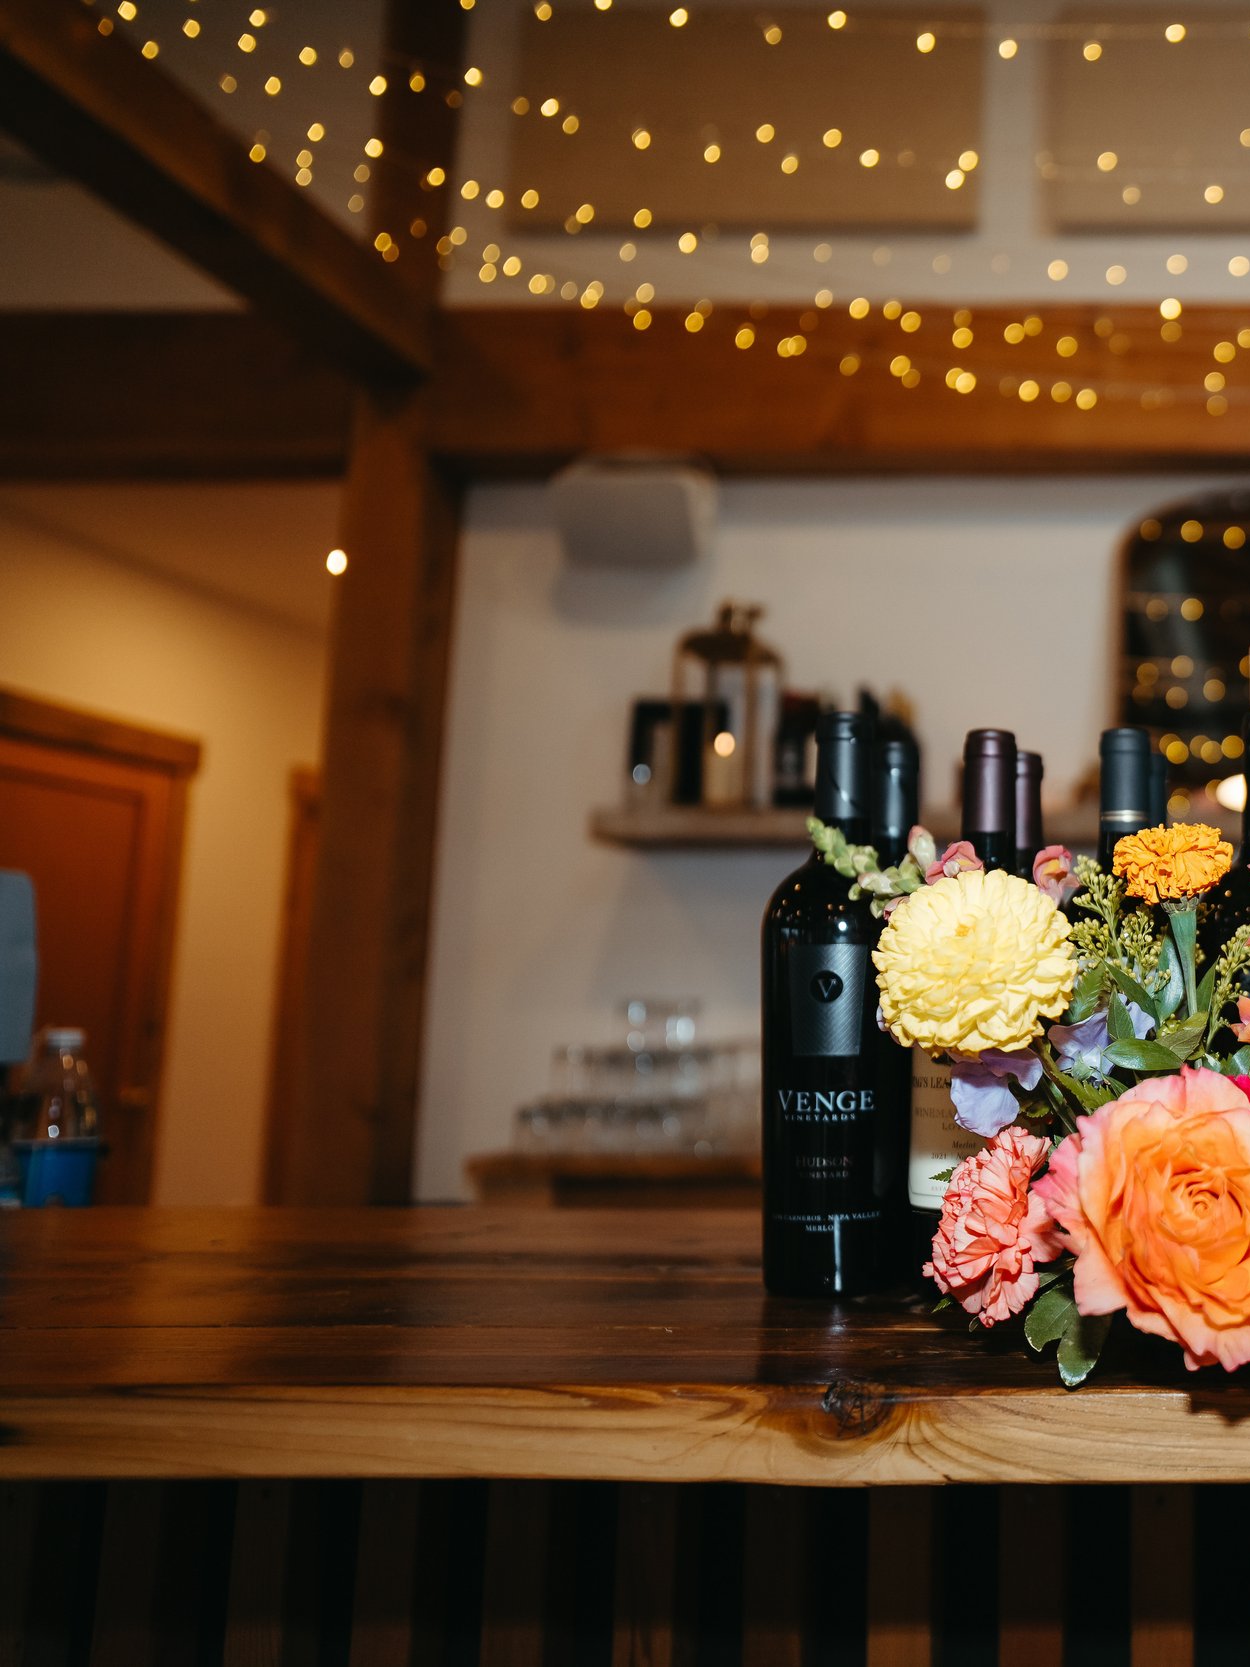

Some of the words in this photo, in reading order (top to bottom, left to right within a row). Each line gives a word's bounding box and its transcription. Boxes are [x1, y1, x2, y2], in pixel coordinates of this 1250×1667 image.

[817, 978, 837, 999] V
[778, 1089, 875, 1112] VENGE
[784, 1113, 857, 1122] VINEYARDS
[952, 1140, 977, 1149] Merlot
[827, 1212, 849, 1221] NPA
[805, 1224, 838, 1232] MERLO
